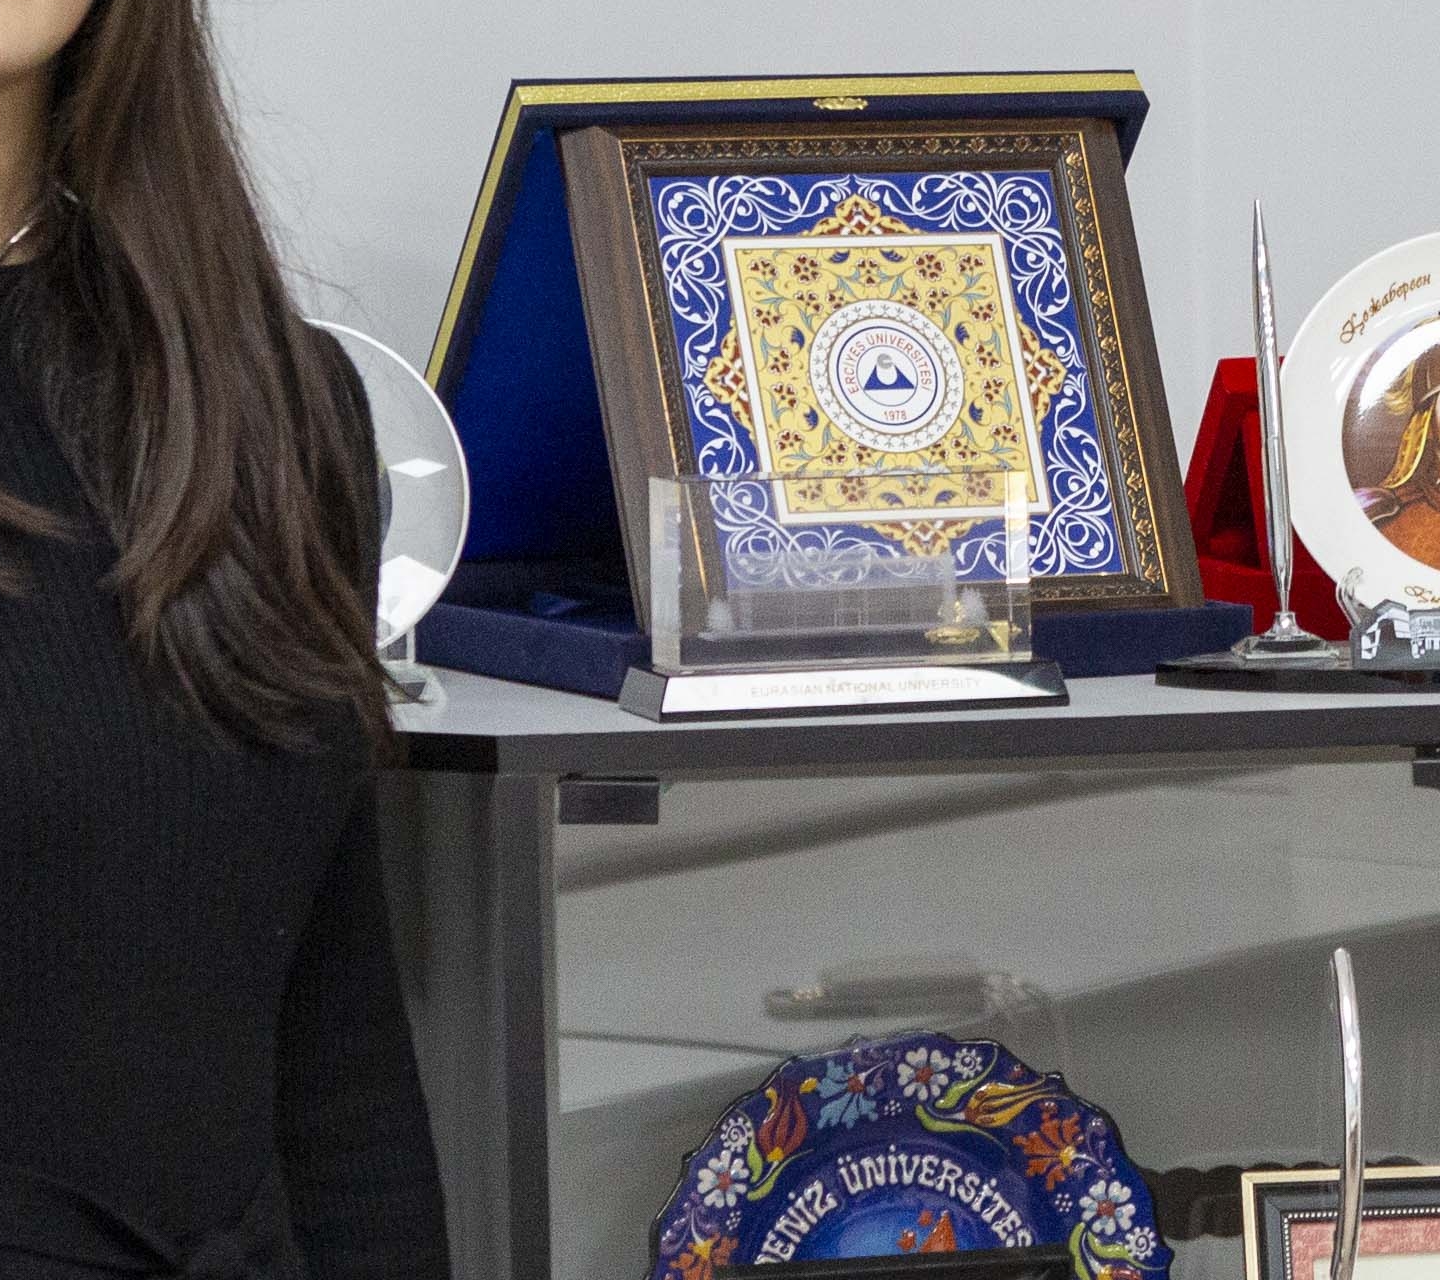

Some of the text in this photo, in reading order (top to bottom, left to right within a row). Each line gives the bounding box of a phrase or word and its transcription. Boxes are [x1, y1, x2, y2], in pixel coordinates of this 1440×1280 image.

[883, 410, 908, 421] 1978
[826, 681, 894, 695] NATIONAL
[898, 678, 982, 692] UNIVERSITY
